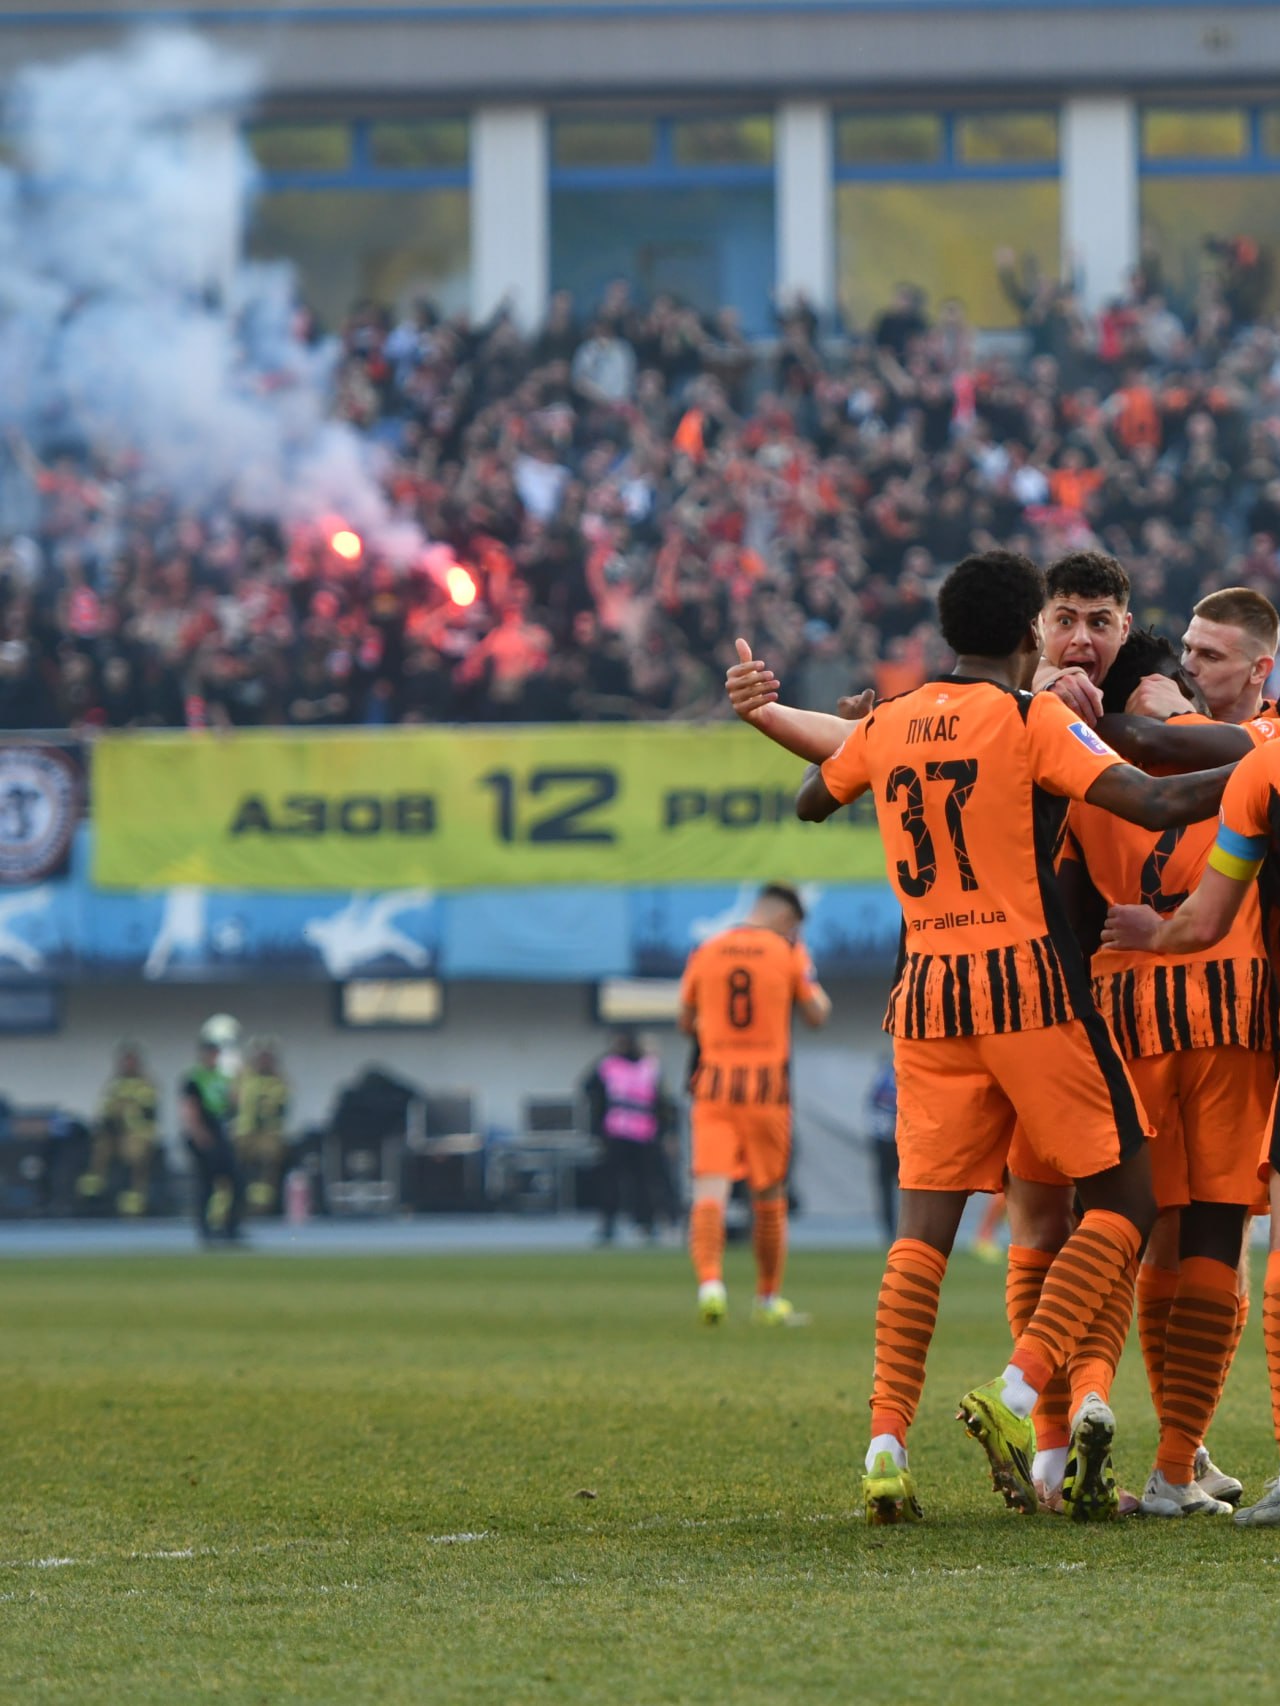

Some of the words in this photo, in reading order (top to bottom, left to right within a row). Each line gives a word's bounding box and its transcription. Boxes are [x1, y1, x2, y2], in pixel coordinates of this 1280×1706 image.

[906, 715, 960, 744] ЛУКАС
[229, 791, 437, 837] АЗОВ
[484, 763, 618, 845] 12
[886, 758, 979, 898] 37
[911, 909, 1007, 932] arallel.ua
[728, 968, 753, 1029] 8
